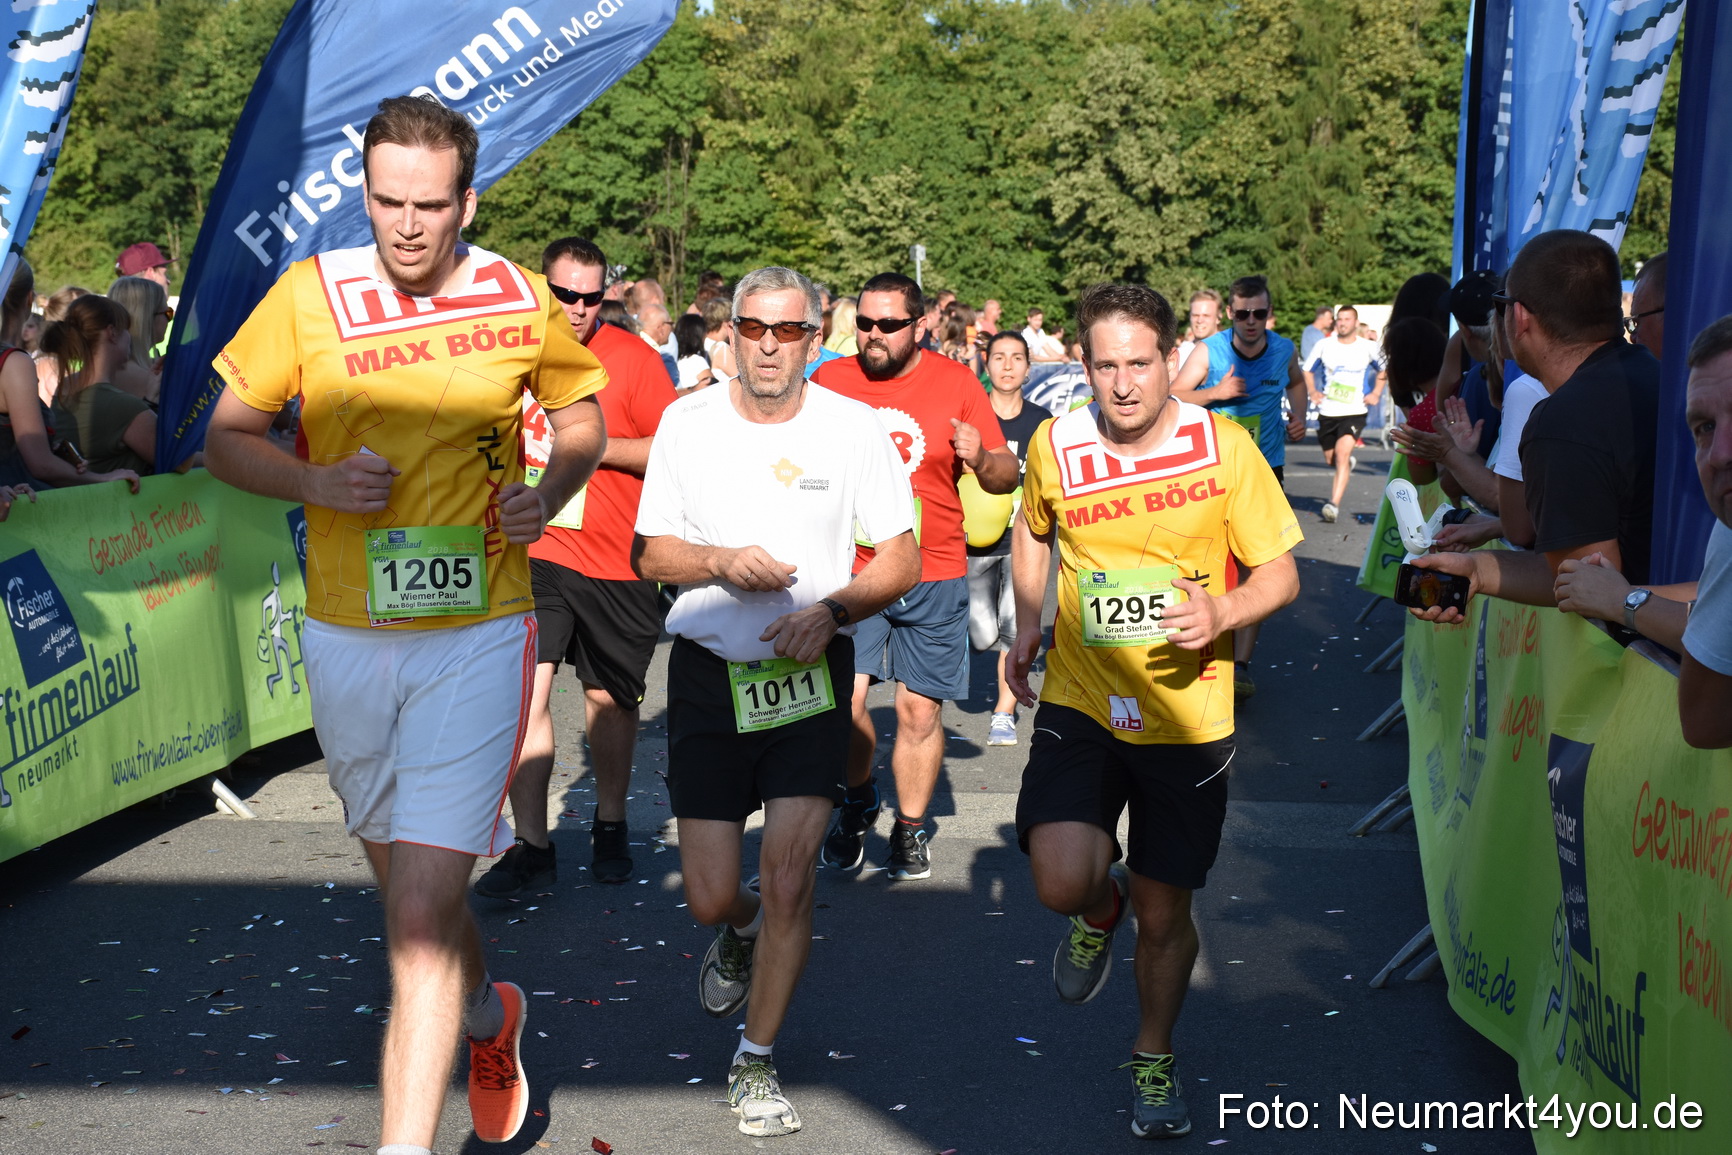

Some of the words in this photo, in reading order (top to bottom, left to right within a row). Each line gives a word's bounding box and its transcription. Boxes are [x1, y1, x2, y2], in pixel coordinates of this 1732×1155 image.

[512, 38, 564, 88] und
[344, 339, 436, 378] MAX
[445, 322, 541, 358] BÖGL
[799, 478, 830, 486] LANDKREIS
[799, 484, 830, 492] NEUMARKT
[1065, 496, 1135, 529] MAX
[1144, 477, 1226, 513] BÖGL
[88, 510, 153, 576] Gesunde
[149, 500, 207, 544] Firmen
[380, 539, 423, 551] firmenlauf
[427, 546, 449, 554] 2018
[132, 560, 187, 613] laufen
[382, 557, 473, 592] 1205
[1087, 580, 1120, 589] firmenlauf
[17, 589, 56, 621] Fischer
[400, 592, 436, 601] Wiemer
[438, 591, 458, 600] Paul
[401, 601, 416, 609] Bögl
[1089, 594, 1166, 625] 1295
[28, 608, 60, 632] AUTOMOBILE
[1105, 625, 1124, 634] Grad
[1126, 624, 1153, 633] Stefan
[4, 622, 141, 762] firmenlauf
[745, 671, 816, 709] 1011
[748, 706, 787, 719] Schweiger
[788, 696, 822, 711] Hermann
[18, 734, 80, 793] neumarkt
